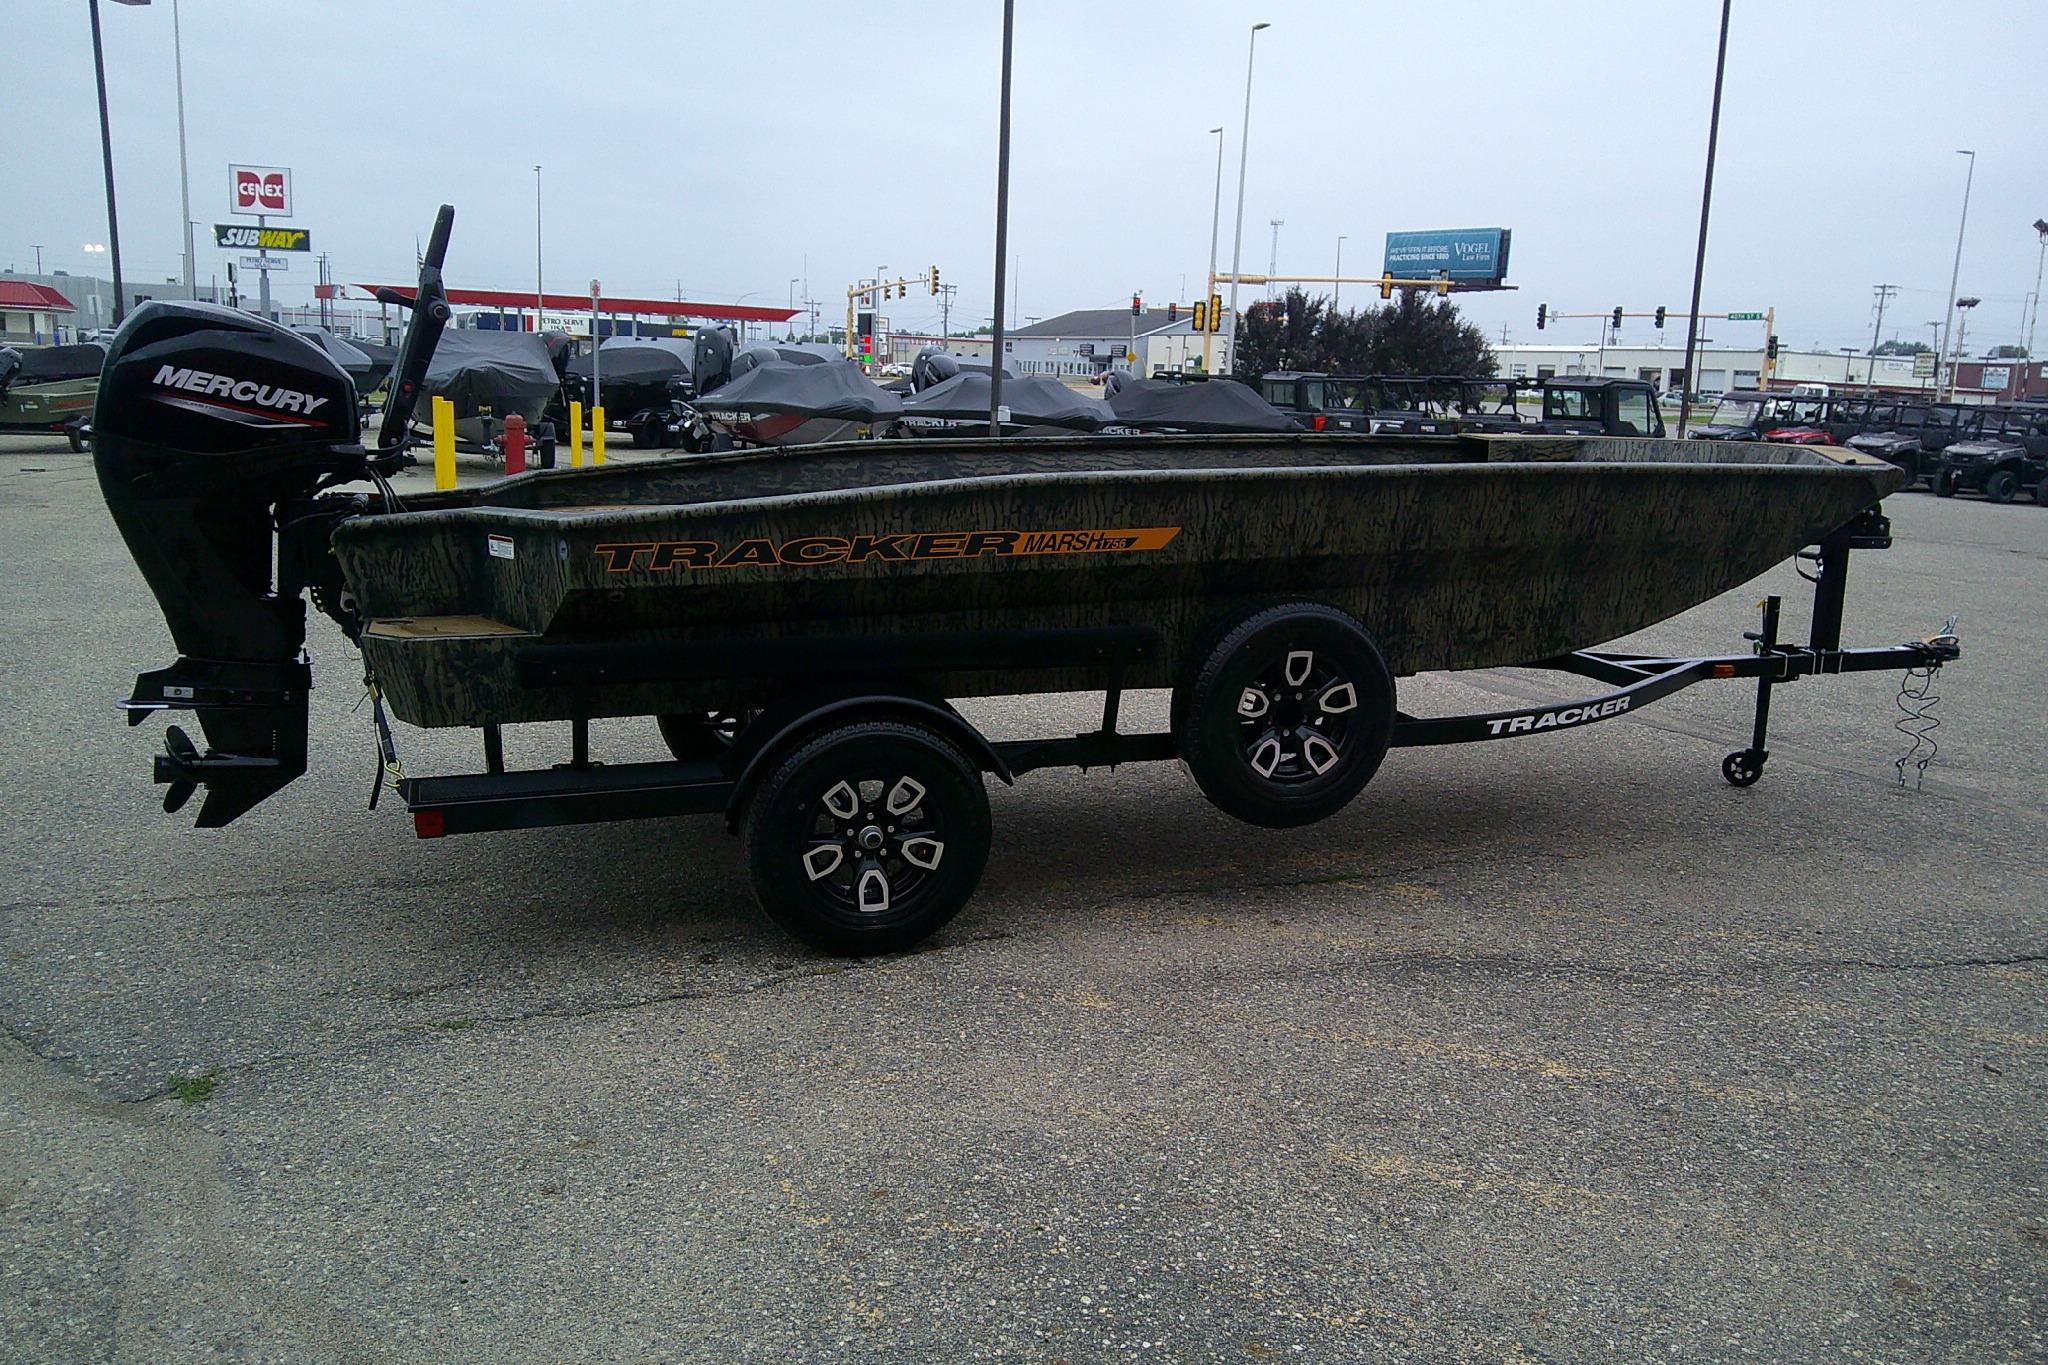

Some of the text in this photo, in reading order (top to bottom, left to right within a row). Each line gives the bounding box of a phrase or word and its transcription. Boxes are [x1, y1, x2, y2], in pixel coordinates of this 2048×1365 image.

[239, 182, 283, 197] CENEX
[220, 227, 305, 248] SUBWAY
[1455, 242, 1490, 256] VOGEL
[1389, 253, 1420, 261] PRACTICING
[153, 364, 328, 415] MERCURY
[710, 411, 751, 421] TRACKER
[1099, 426, 1141, 436] ACKER
[594, 530, 1127, 572] TRACKER MARSH 1756
[1487, 696, 1631, 735] TRACKER
